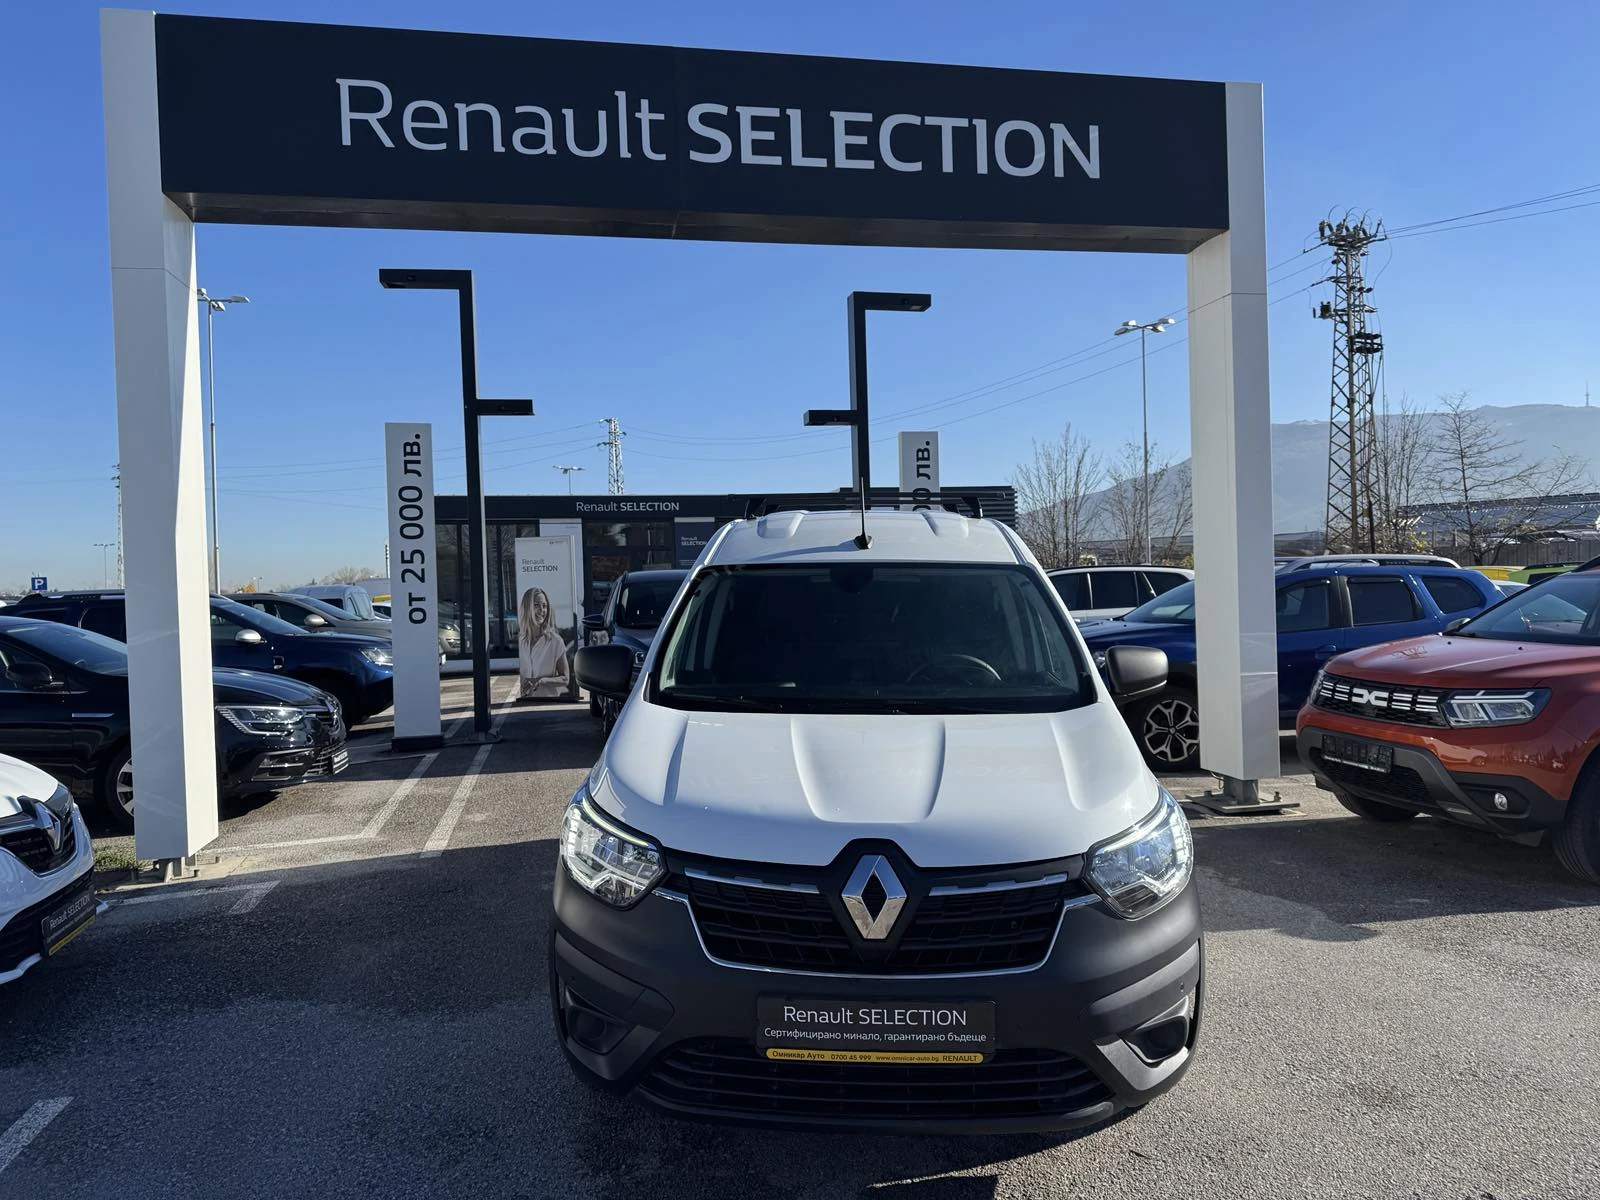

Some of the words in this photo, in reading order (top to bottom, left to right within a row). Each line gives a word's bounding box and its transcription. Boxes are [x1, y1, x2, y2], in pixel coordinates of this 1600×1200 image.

[336, 78, 667, 161] Renault
[687, 103, 1100, 179] SELECTION
[403, 433, 422, 477] лв.
[916, 440, 931, 480] лв.
[398, 485, 424, 540] 000
[576, 501, 618, 512] Renault
[620, 502, 680, 512] SELECTION
[400, 549, 425, 583] 25
[34, 578, 44, 590] P
[408, 592, 427, 625] от
[783, 1006, 854, 1025] Renault
[858, 1008, 967, 1026] SELECTION
[764, 1027, 842, 1040] Сертифицирано
[843, 1030, 882, 1042] минало,
[884, 1032, 946, 1042] гарантирано
[947, 1031, 987, 1042] бъдеще
[772, 1050, 805, 1059] Омникар
[807, 1051, 825, 1060] Ауто
